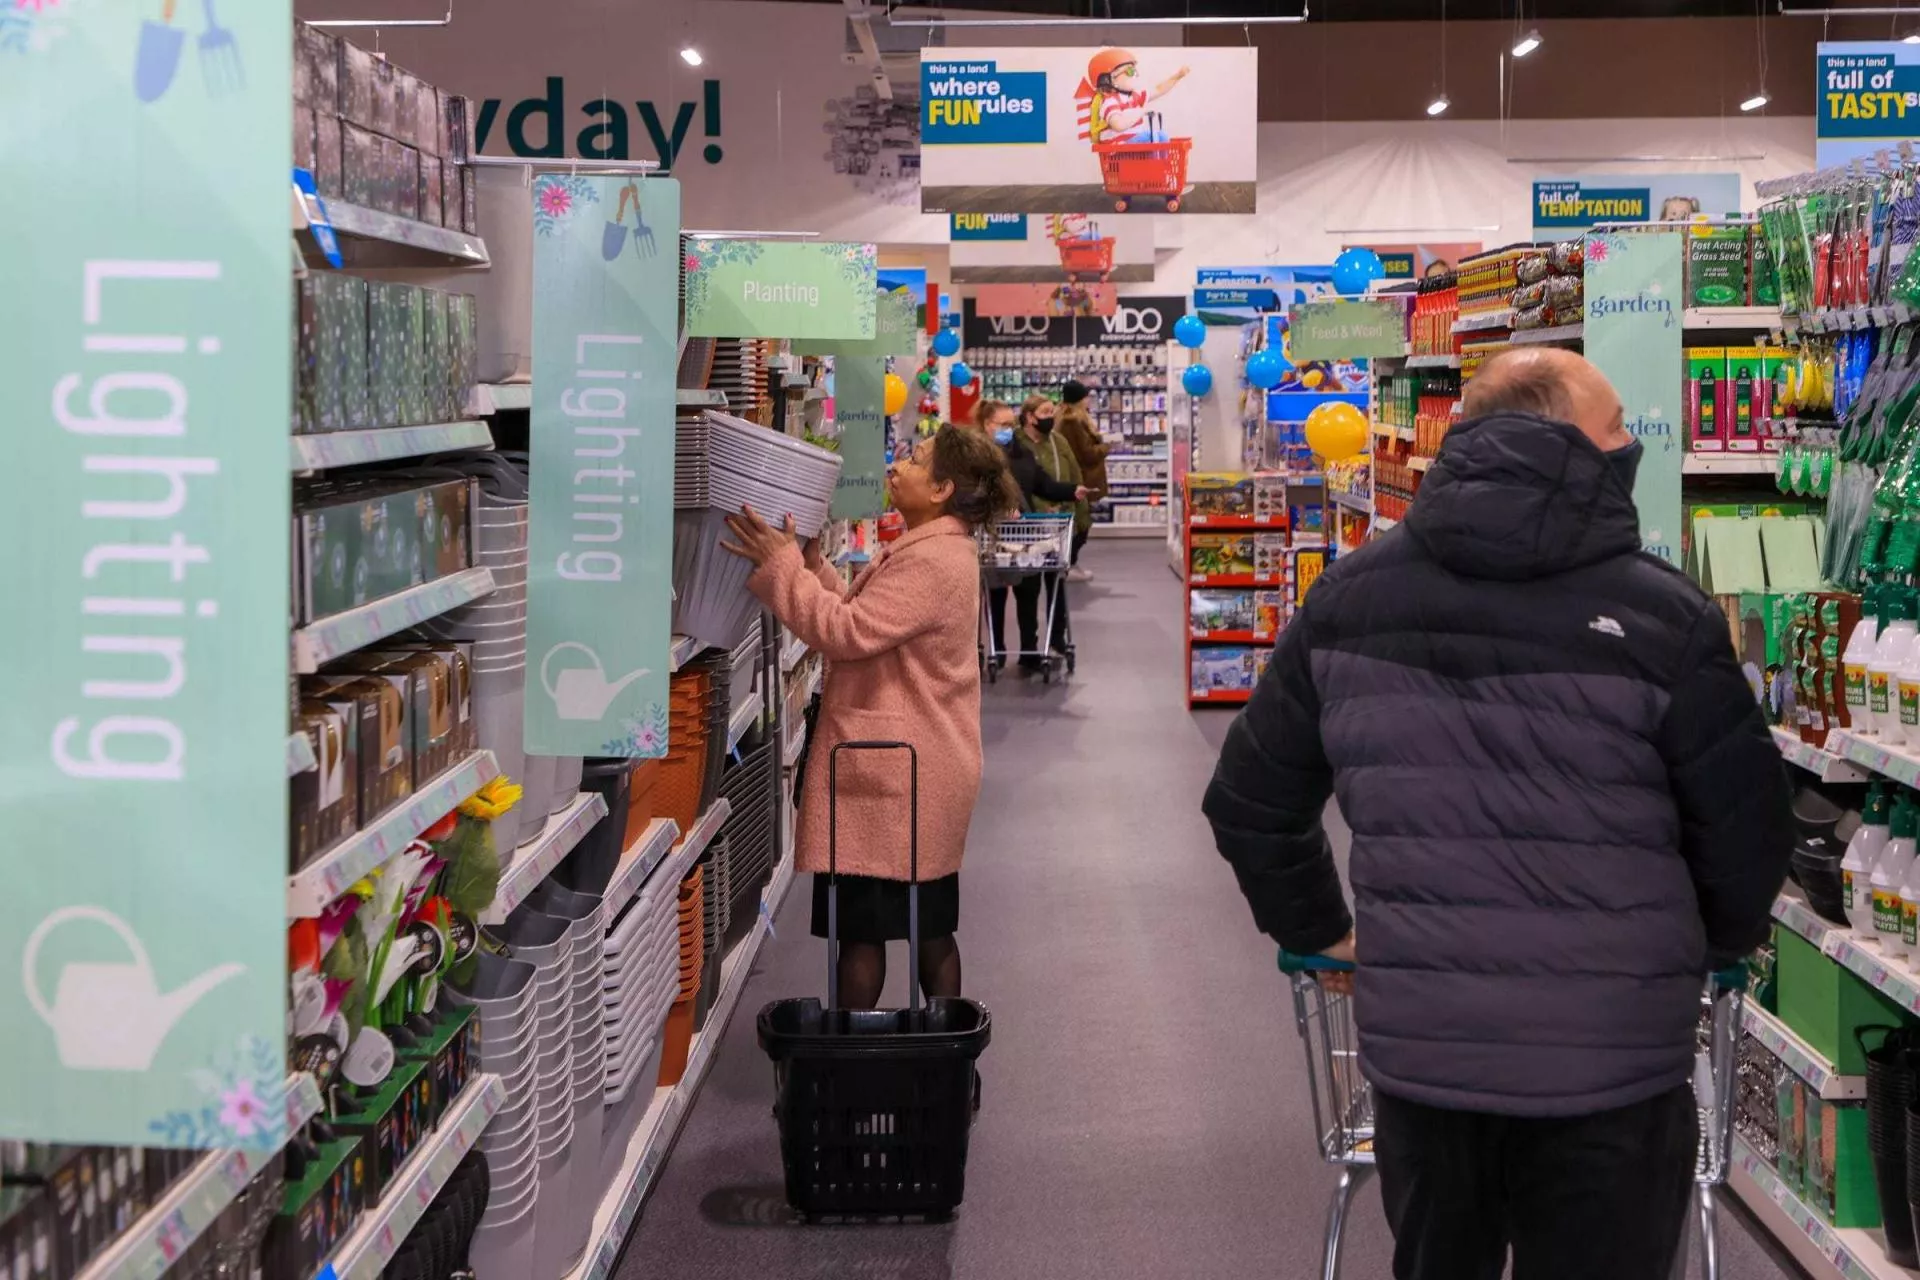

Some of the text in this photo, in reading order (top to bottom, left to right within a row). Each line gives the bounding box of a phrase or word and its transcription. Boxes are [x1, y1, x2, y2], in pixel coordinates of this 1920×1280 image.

[929, 64, 989, 74] this is a land
[1827, 57, 1887, 67] this is a land
[929, 77, 1001, 96] where
[1827, 69, 1894, 89] full of
[928, 94, 1034, 125] FUN rules
[1826, 92, 1907, 119] TASTY
[1539, 191, 1580, 204] full of
[1539, 199, 1643, 217] TEMPTATION
[955, 213, 988, 230] FUN
[1692, 240, 1741, 252] Fast Acting
[1692, 250, 1742, 261] Grass Seed
[743, 281, 819, 307] Planting
[1590, 292, 1672, 318] garden
[1312, 323, 1383, 340] Feed & Weed
[837, 410, 880, 423] garden
[557, 334, 643, 581] Lighting
[836, 477, 879, 488] garden
[51, 260, 221, 781] Lighting
